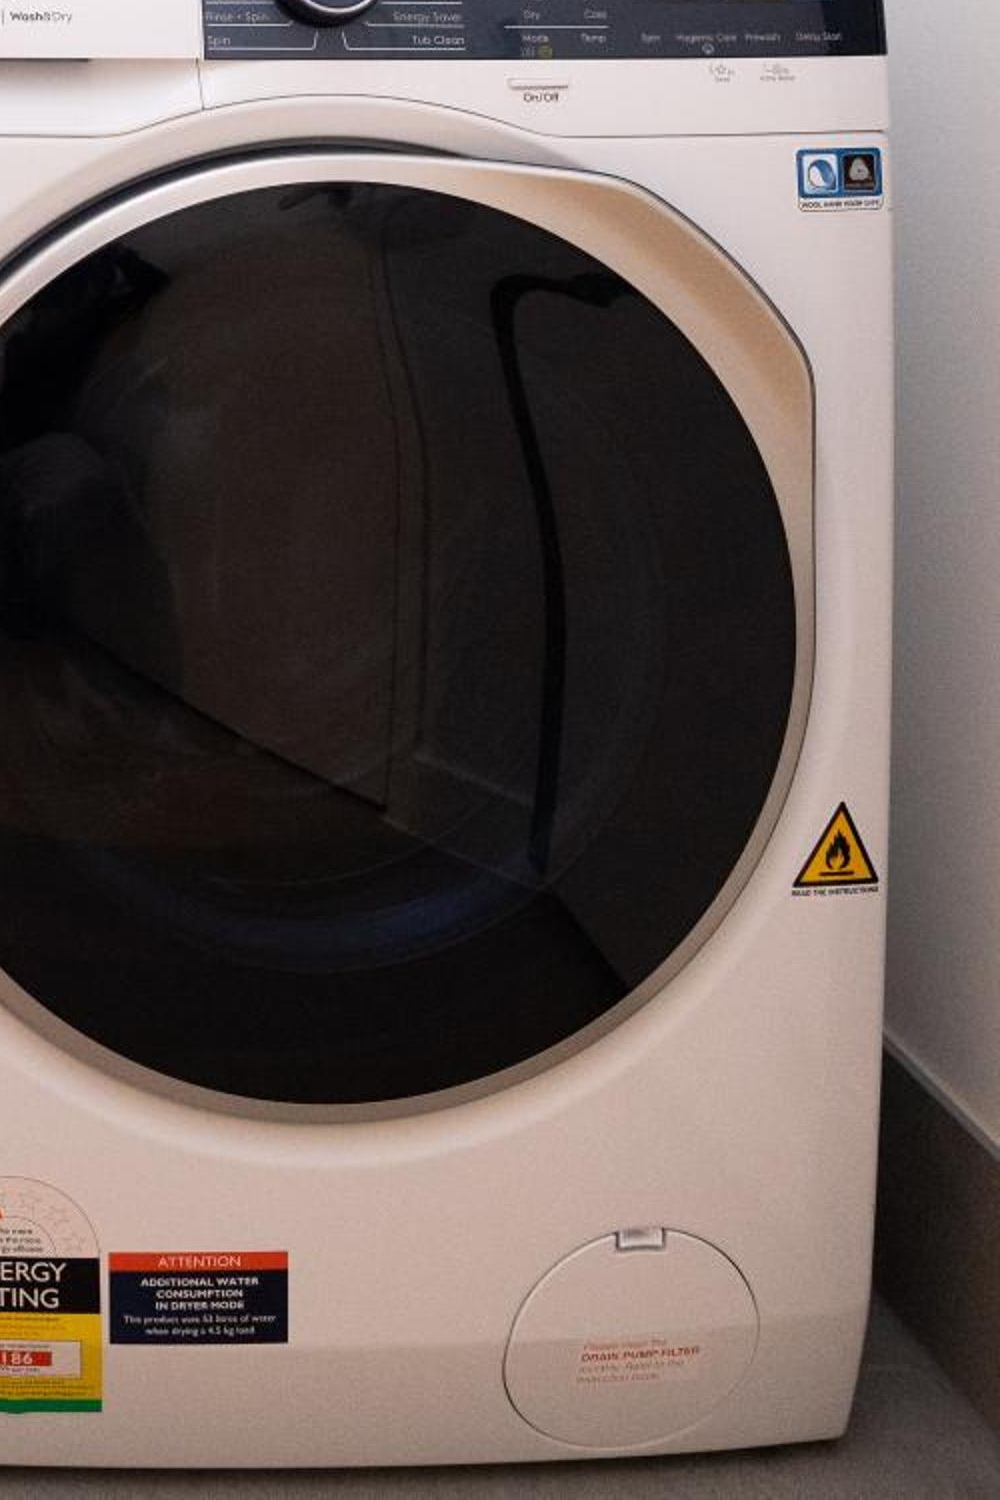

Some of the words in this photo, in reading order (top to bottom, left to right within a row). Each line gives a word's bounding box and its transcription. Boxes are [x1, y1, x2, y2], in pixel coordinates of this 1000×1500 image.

[157, 1255, 242, 1268] ATTENTION
[140, 1277, 215, 1288] ADDITIONAL
[217, 1277, 260, 1287] WATER
[156, 1289, 244, 1299] CONSUMPTION
[155, 1301, 168, 1311] IN
[171, 1301, 209, 1311] DRYER
[210, 1301, 245, 1310] MODE
[143, 1315, 180, 1325] product
[171, 1327, 199, 1337] drying
[223, 1327, 235, 1336] kg
[1, 1352, 33, 1365] 186
